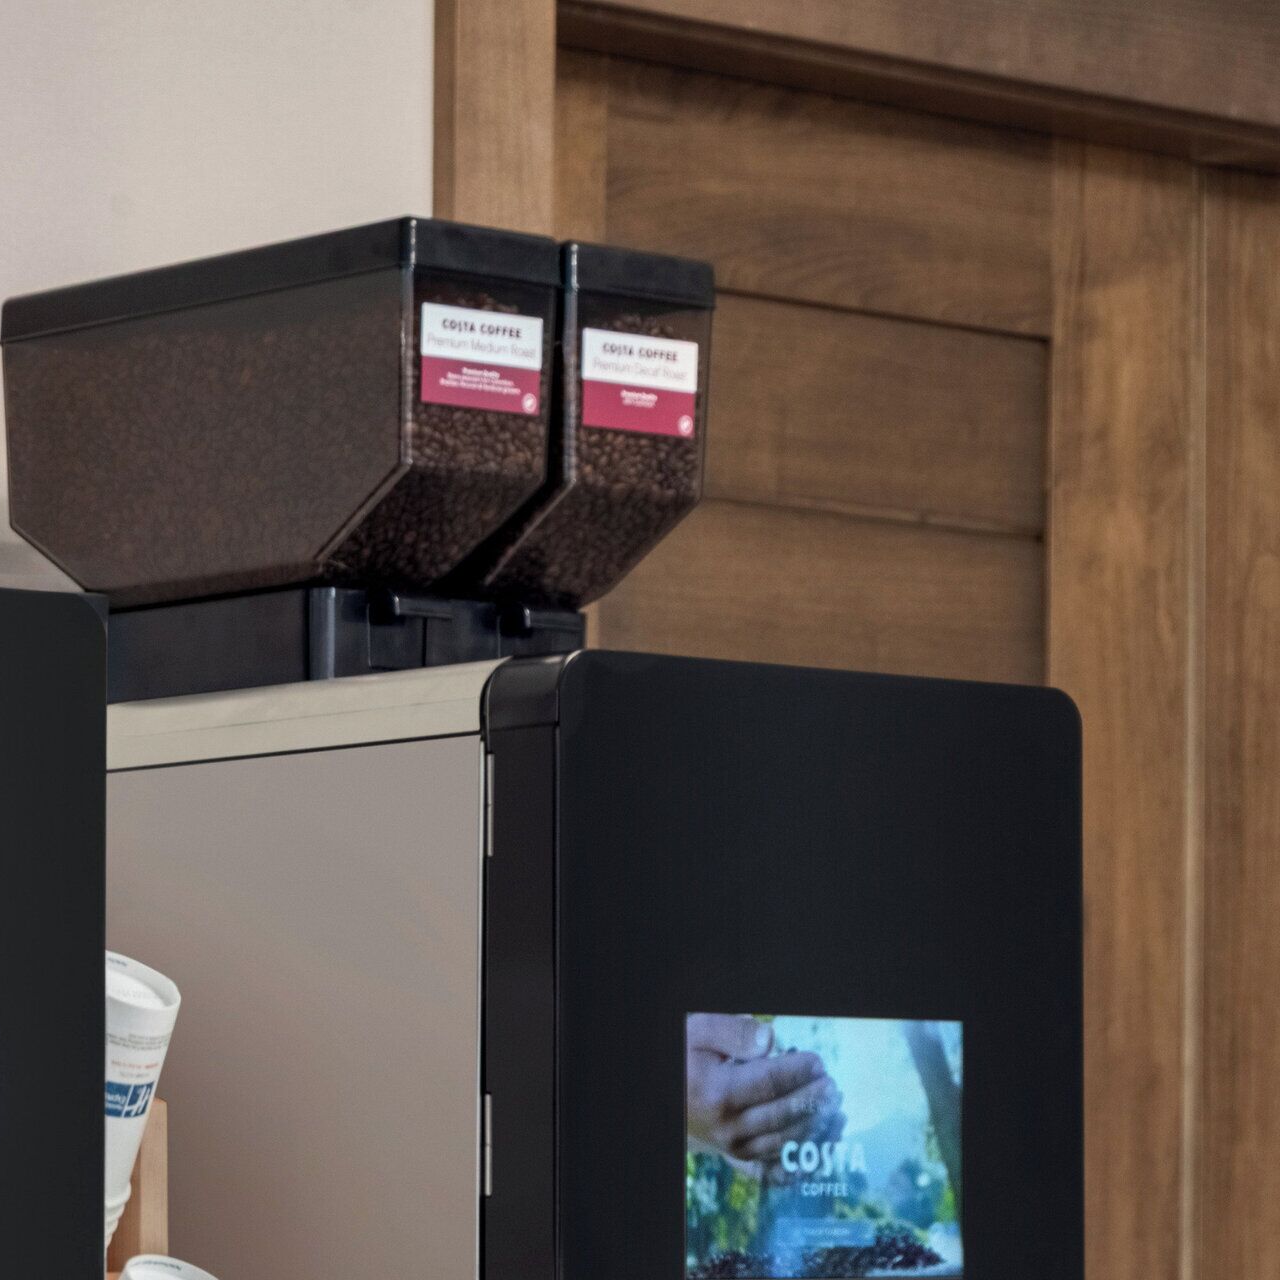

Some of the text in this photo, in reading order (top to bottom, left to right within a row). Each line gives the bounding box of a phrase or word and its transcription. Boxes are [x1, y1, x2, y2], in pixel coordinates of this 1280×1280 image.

[442, 317, 522, 339] COSTA COFFEE
[602, 342, 679, 362] COSTA COFFEE
[781, 1140, 866, 1178] COSTA
[801, 1182, 849, 1197] COFFEE
